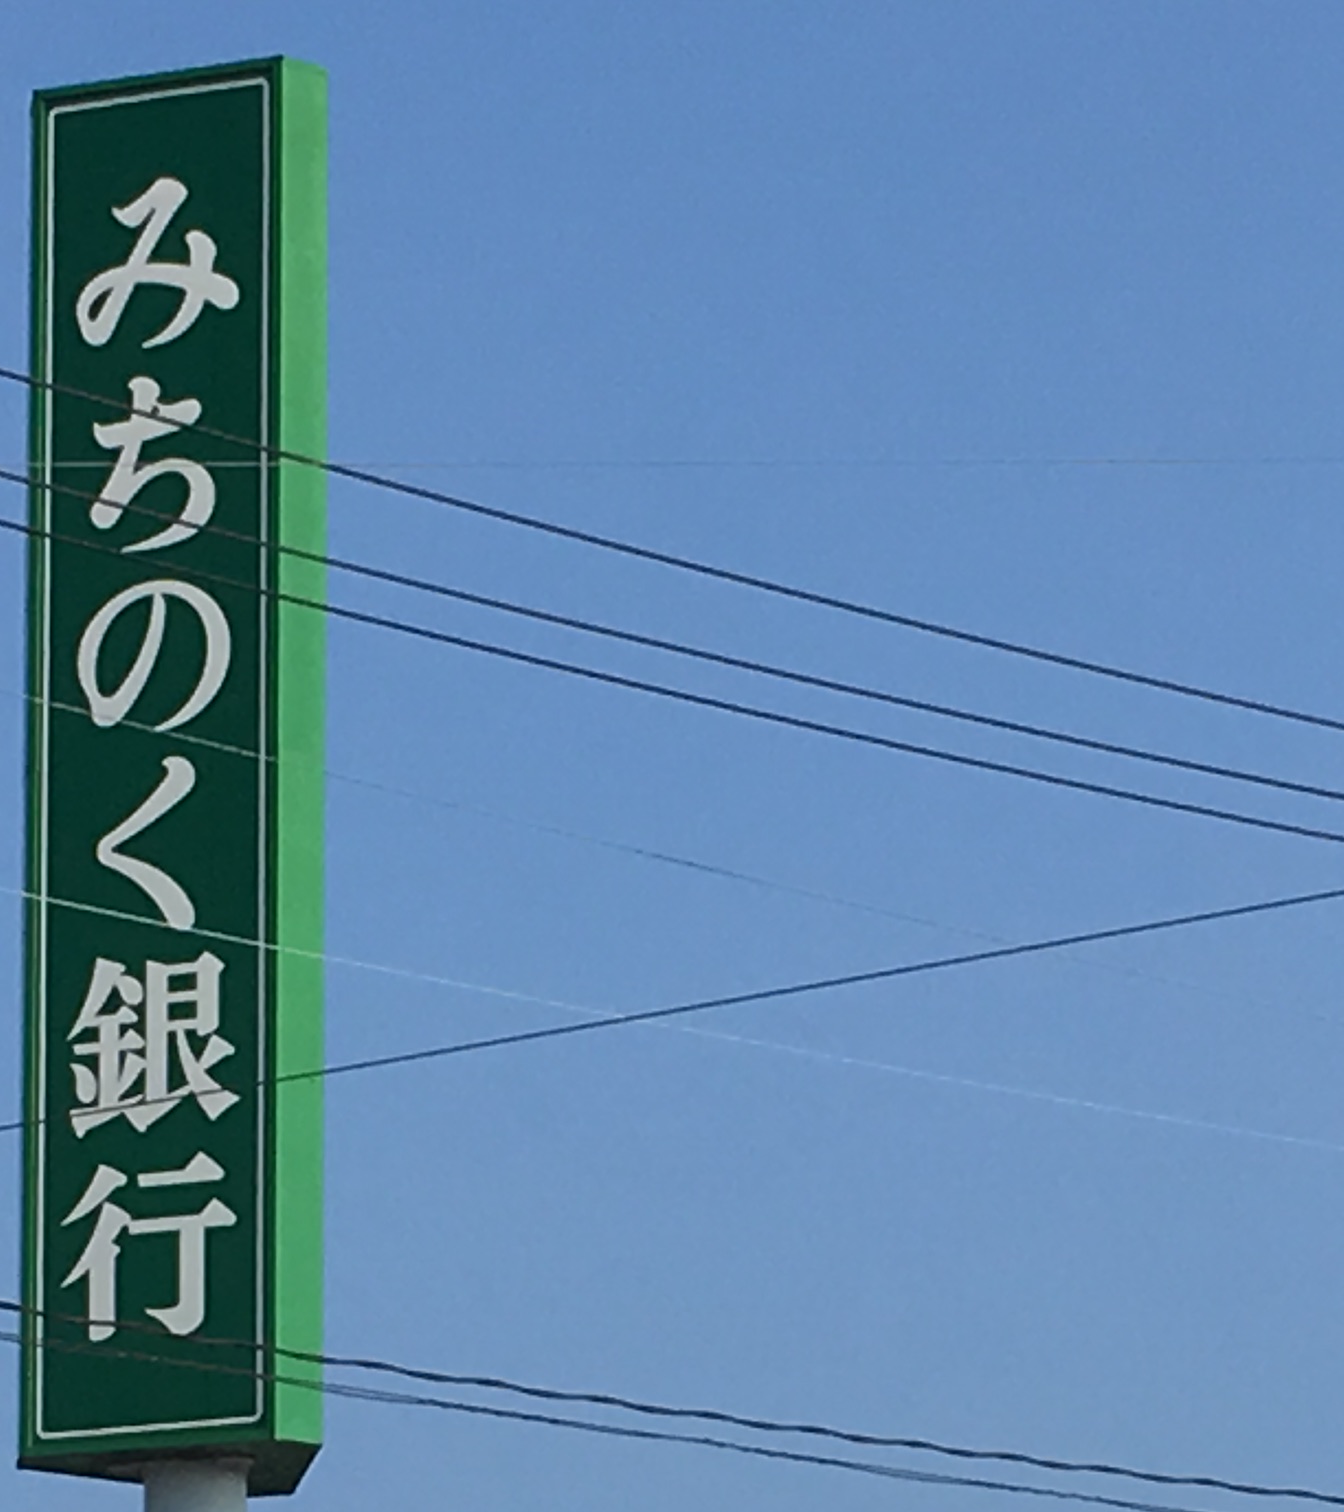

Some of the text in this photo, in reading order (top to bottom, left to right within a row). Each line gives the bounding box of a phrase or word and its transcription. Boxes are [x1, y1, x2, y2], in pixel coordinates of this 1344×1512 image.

[60, 176, 241, 1342] みちのく銀行
